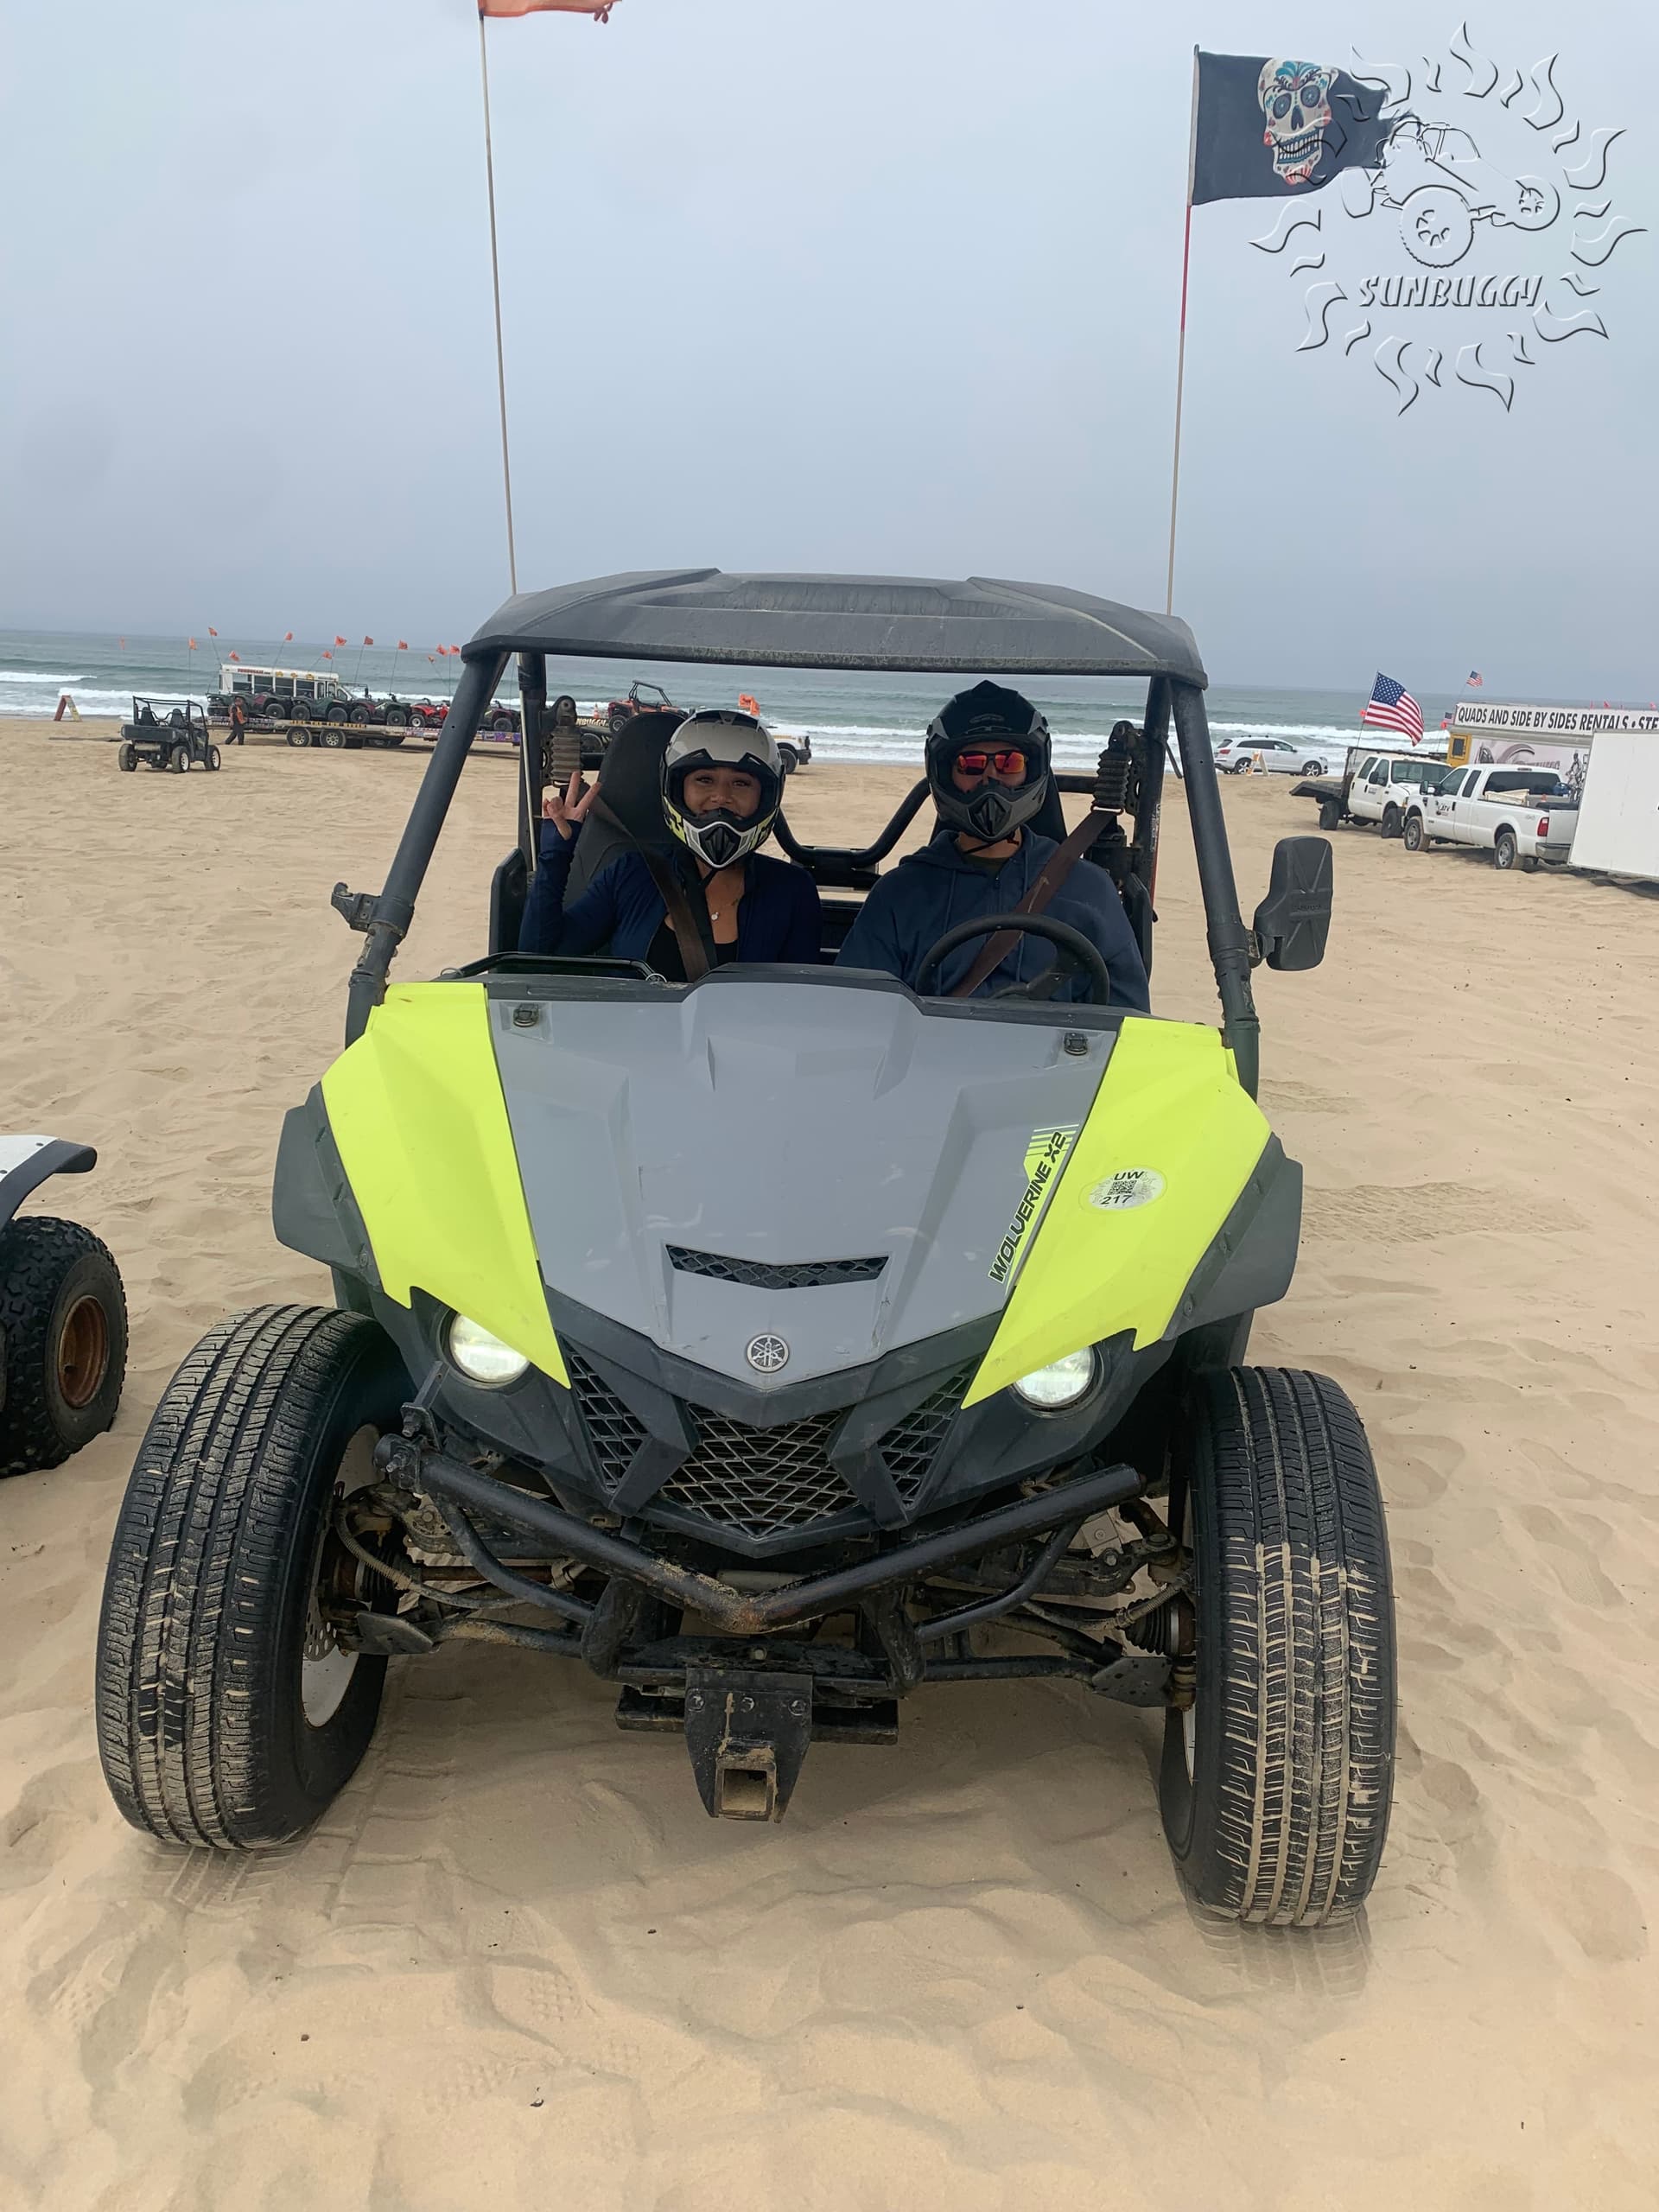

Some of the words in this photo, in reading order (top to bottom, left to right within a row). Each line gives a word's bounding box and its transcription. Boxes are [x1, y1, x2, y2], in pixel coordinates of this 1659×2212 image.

[1458, 707, 1487, 723] QUADS
[1488, 709, 1510, 725] AND
[1510, 710, 1532, 727] SIDE
[1533, 711, 1548, 728] BY
[1548, 711, 1578, 730] SIDES
[1113, 1170, 1145, 1181] UW
[988, 1160, 1052, 1282] WOLVERINE
[1043, 1131, 1066, 1163] X2
[1100, 1194, 1133, 1205] 217
